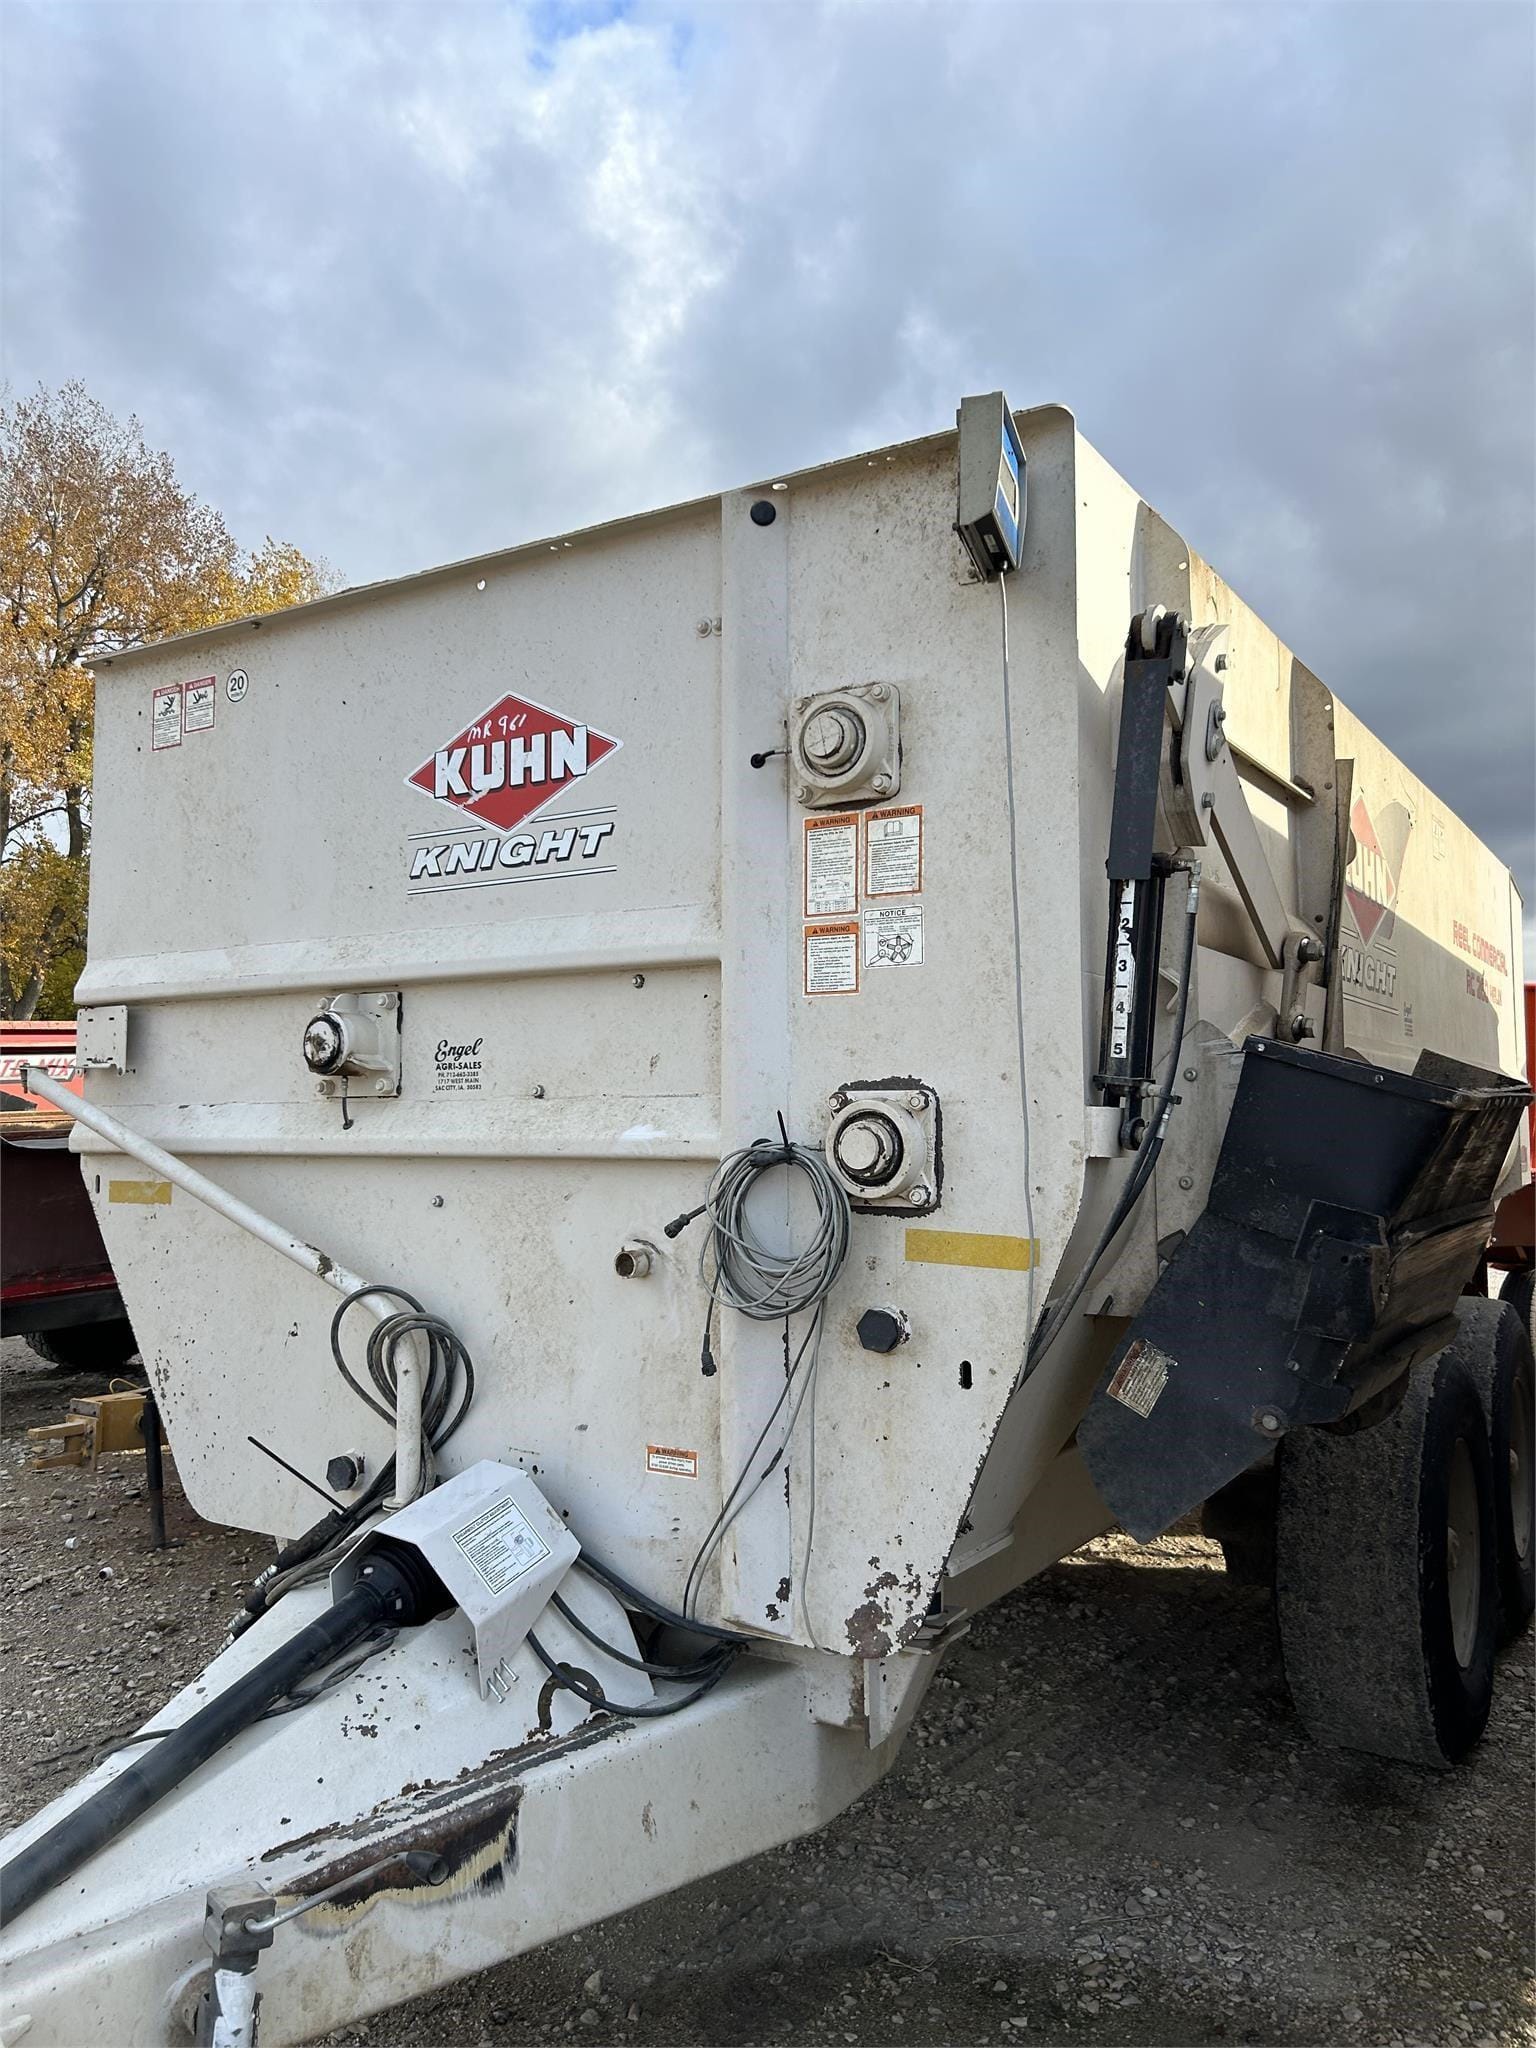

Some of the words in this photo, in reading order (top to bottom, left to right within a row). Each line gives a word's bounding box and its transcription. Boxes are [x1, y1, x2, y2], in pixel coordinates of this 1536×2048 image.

[230, 676, 245, 692] 20
[434, 725, 588, 799] KUHN
[880, 807, 916, 818] WARNING
[819, 816, 851, 827] WARNING
[409, 821, 615, 880] KNIGHT
[1346, 843, 1390, 909] UHN
[879, 909, 906, 917] NOTICE
[819, 925, 850, 935] WARNING
[1121, 917, 1130, 930] 2
[1118, 959, 1127, 972] 3
[1115, 1001, 1125, 1014] 4
[434, 1038, 483, 1062] Engel
[1113, 1042, 1123, 1055] 5
[436, 1061, 482, 1071] AGRI-SALES
